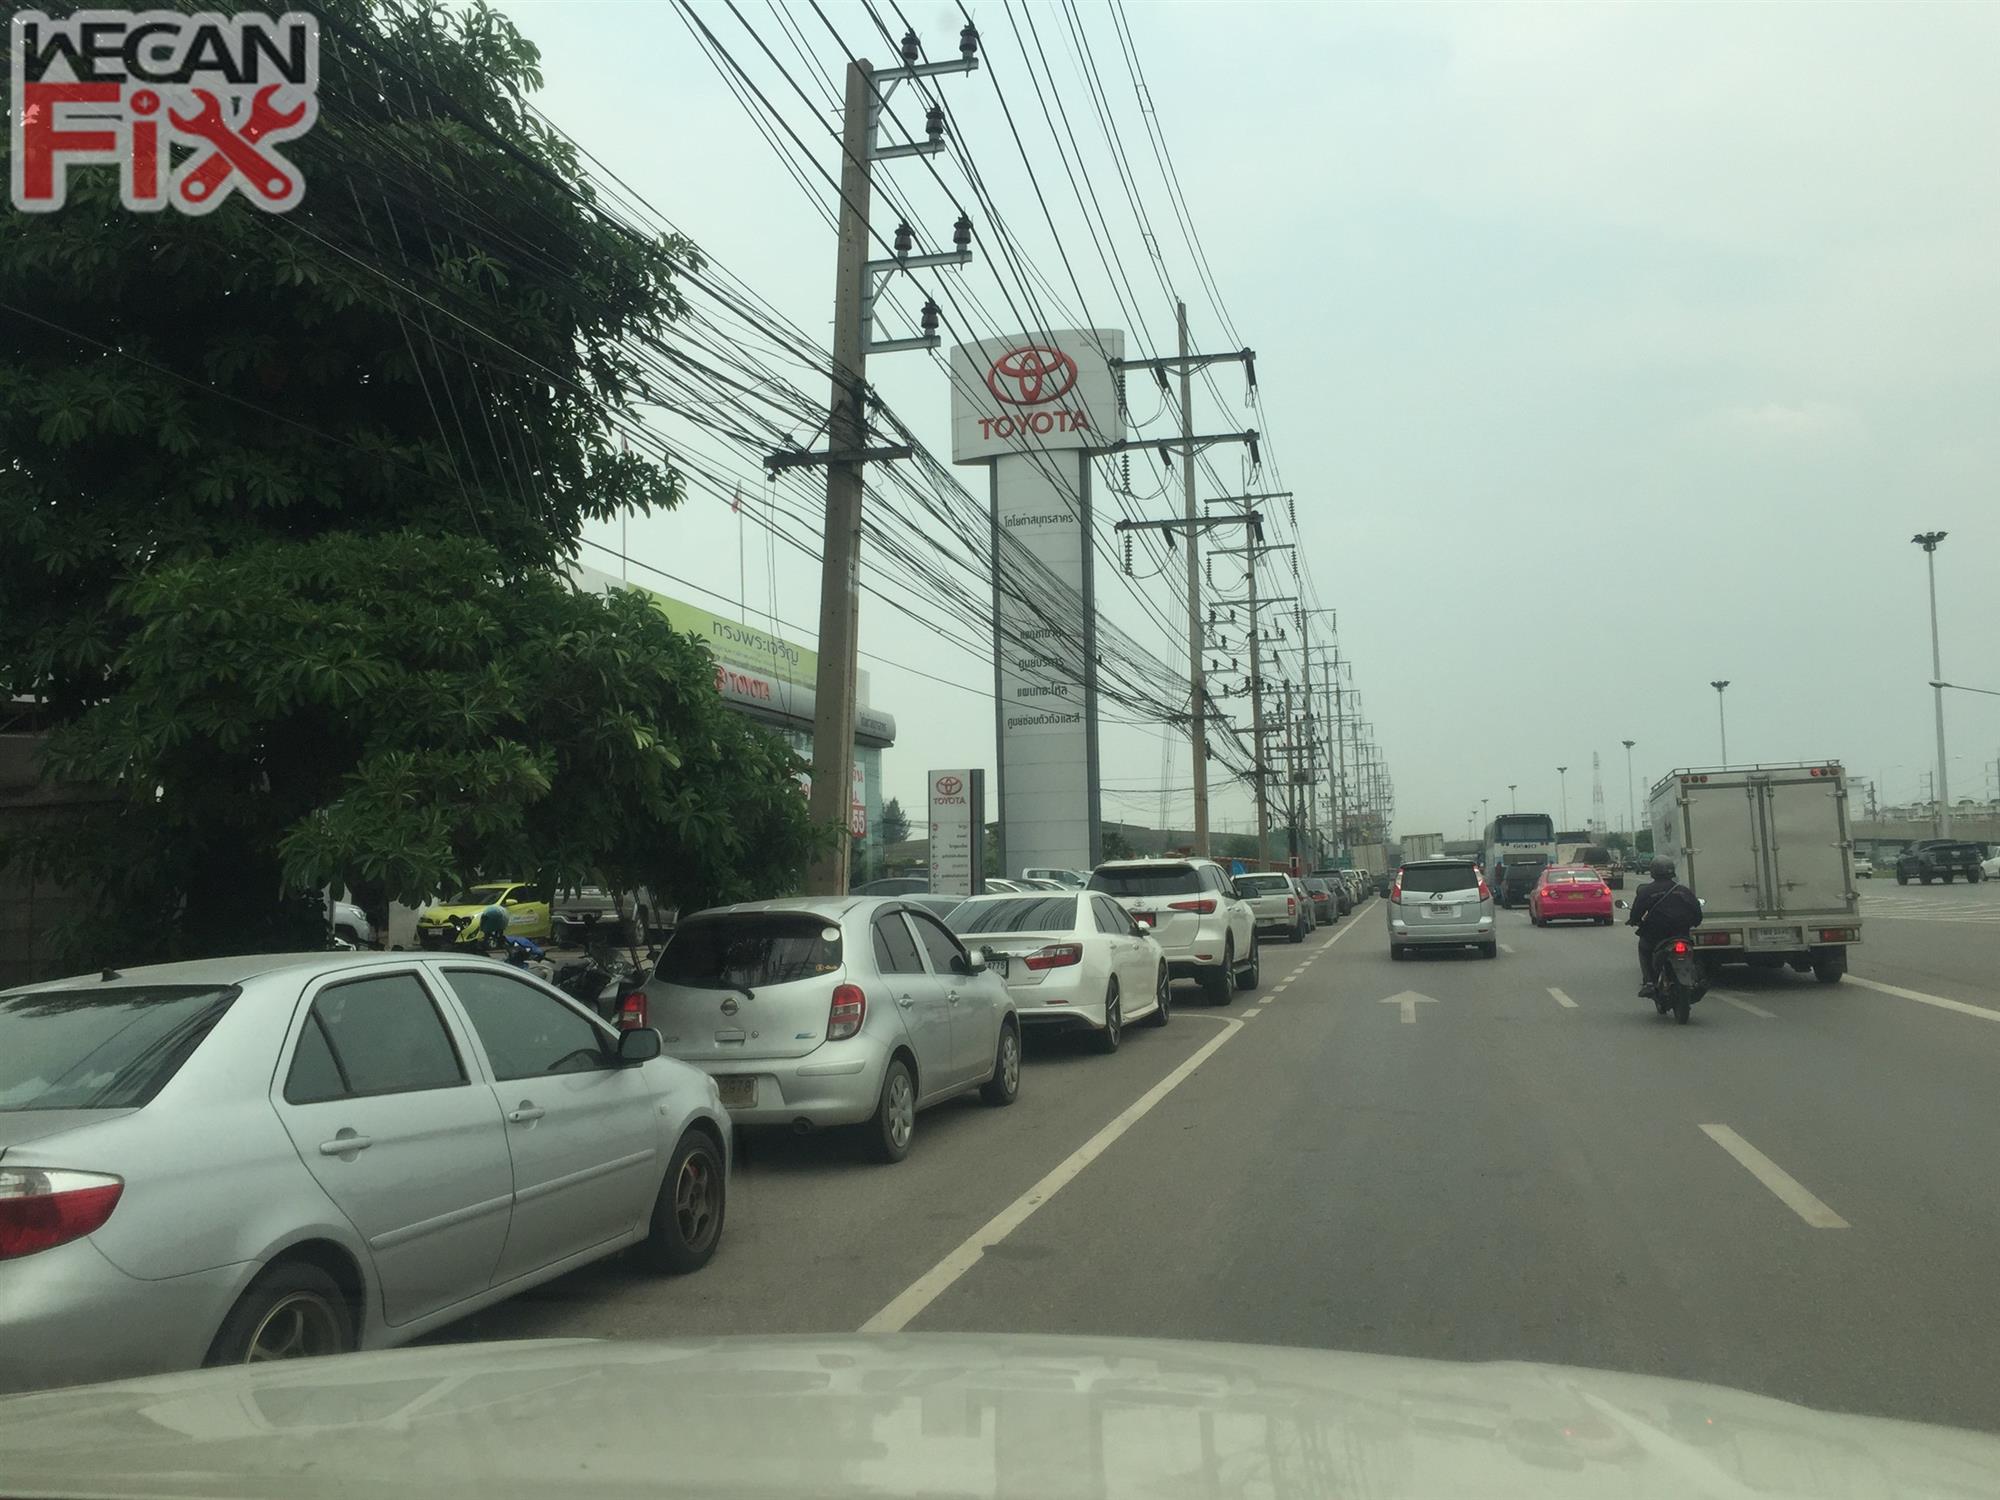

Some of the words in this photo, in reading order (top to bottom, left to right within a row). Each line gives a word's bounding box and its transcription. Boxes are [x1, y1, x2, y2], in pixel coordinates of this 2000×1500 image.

[978, 410, 1090, 440] TOYOTA
[713, 620, 799, 666] ทรงพระเจริญ
[728, 671, 770, 701] TOYOTA
[933, 797, 967, 805] TOYOTA
